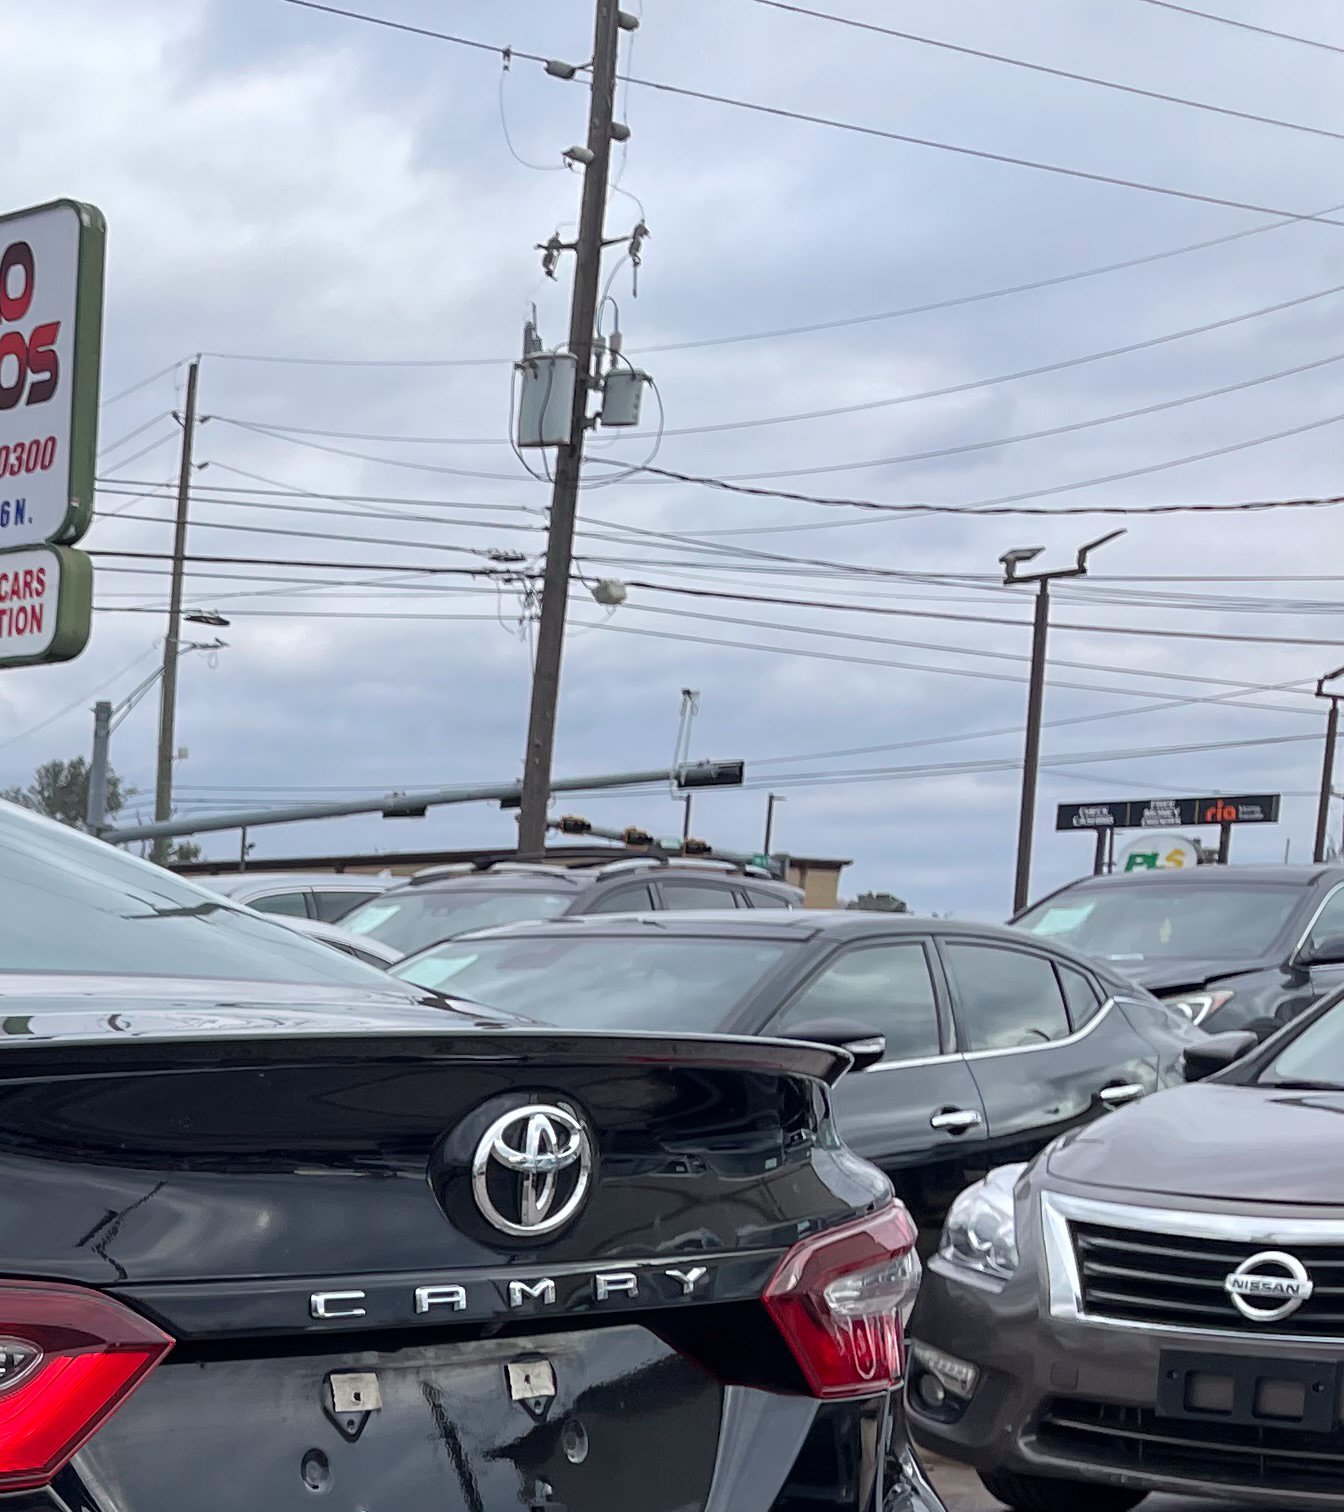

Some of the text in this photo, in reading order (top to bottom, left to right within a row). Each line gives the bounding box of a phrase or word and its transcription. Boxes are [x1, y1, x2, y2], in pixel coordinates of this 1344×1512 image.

[0, 500, 12, 529] 6
[309, 1265, 708, 1319] CAMRY
[1230, 1277, 1302, 1296] NISSAN
